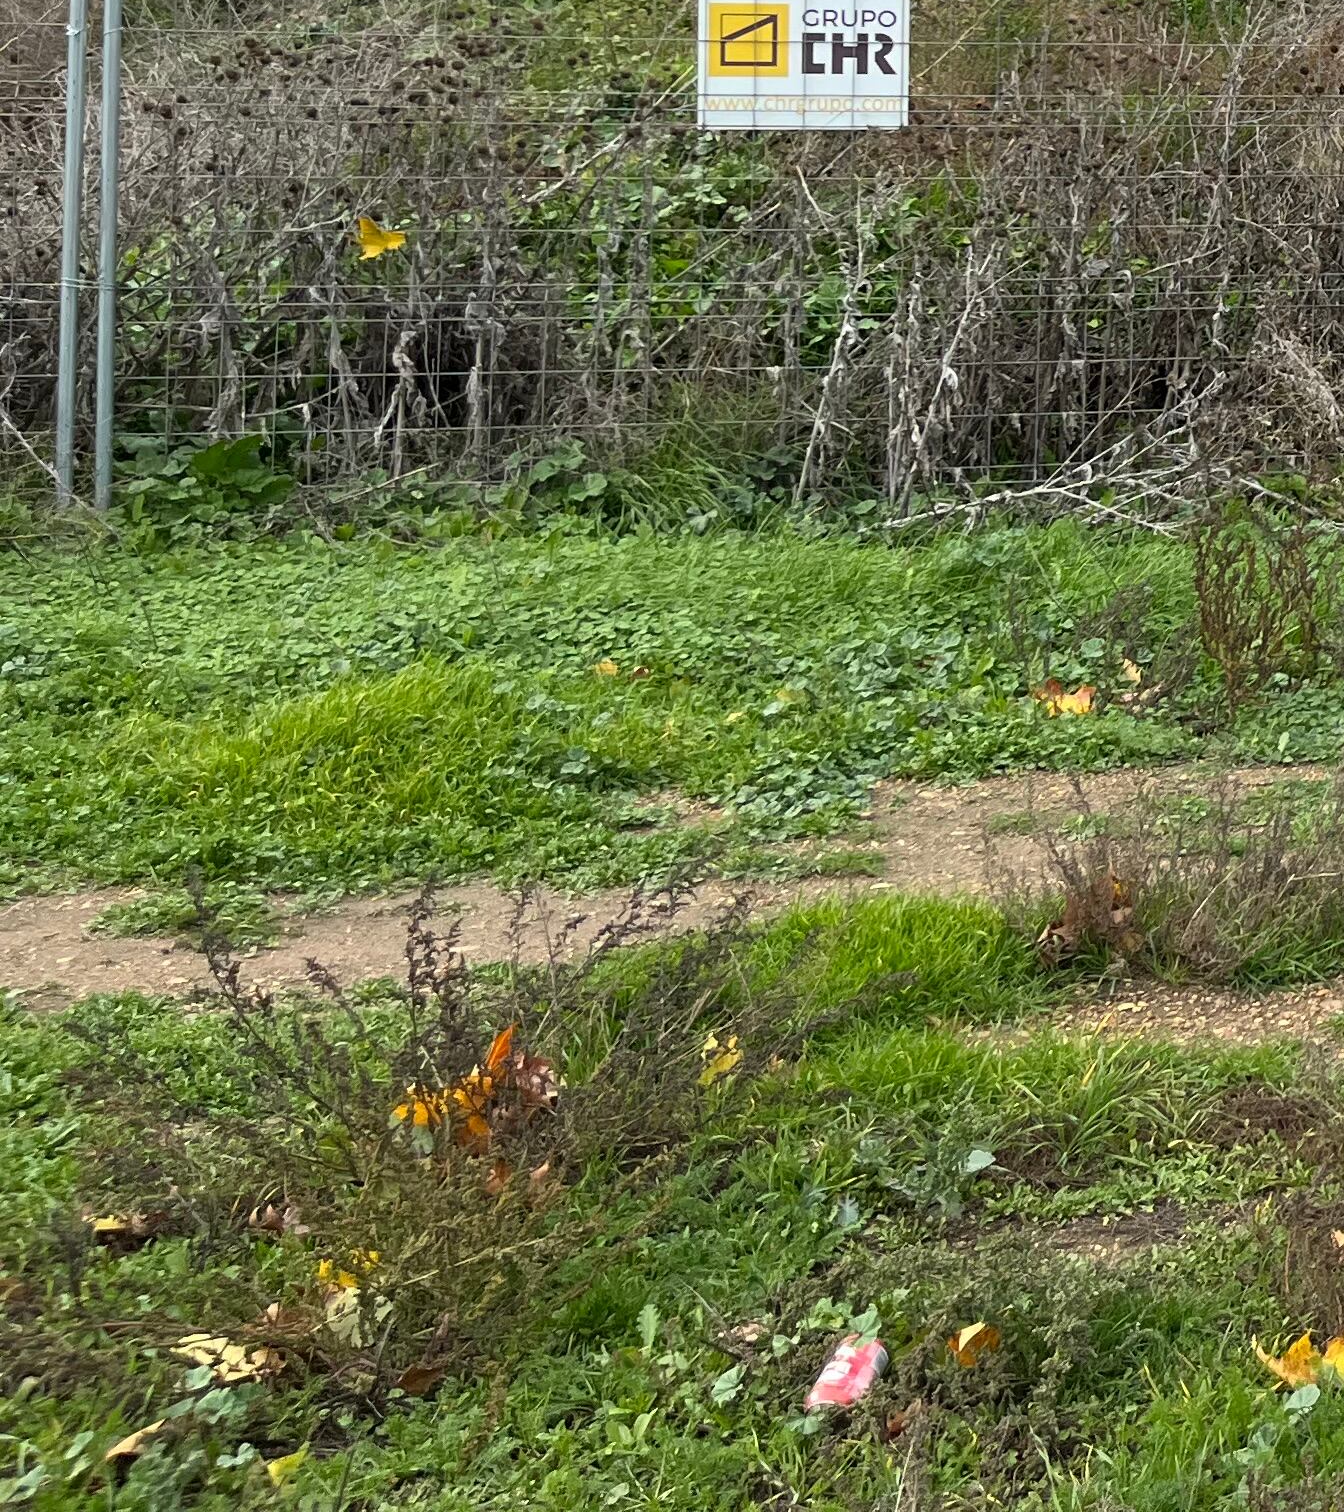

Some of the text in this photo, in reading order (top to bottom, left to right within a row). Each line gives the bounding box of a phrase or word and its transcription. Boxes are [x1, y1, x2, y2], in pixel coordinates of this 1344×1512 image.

[801, 9, 897, 27] GRUPO
[801, 32, 897, 75] CHR
[705, 95, 901, 115] www.chrgrupo.com
